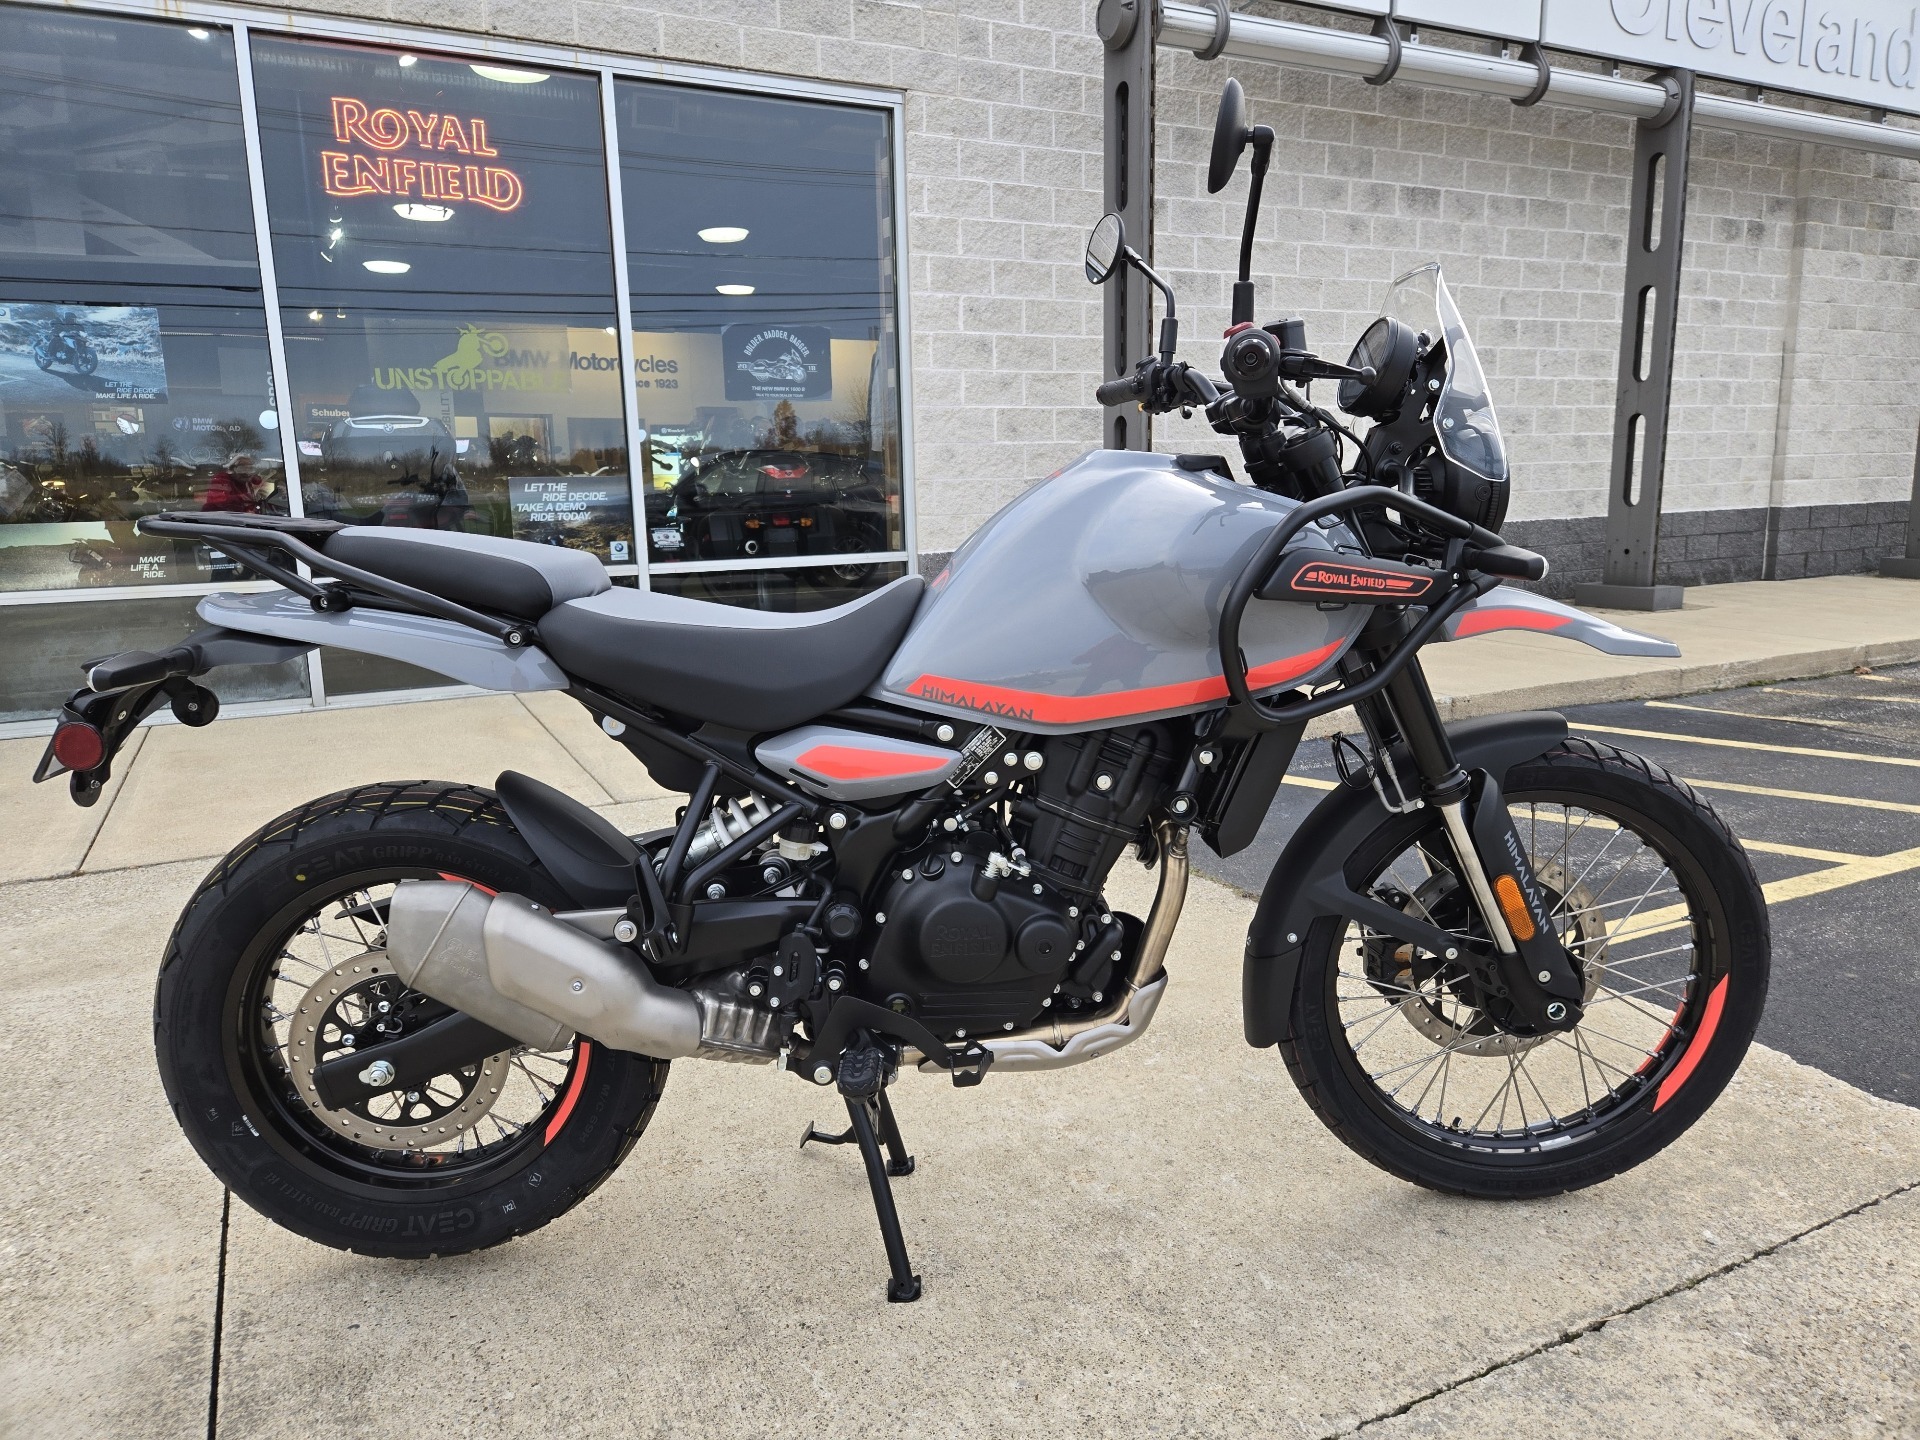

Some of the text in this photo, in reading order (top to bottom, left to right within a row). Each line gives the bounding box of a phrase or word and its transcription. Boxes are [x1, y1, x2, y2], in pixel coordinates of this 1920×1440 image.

[331, 97, 498, 157] ROYAL
[321, 151, 523, 211] ENFIELD
[374, 367, 567, 392] UNSTOPPABLE
[654, 378, 679, 389] 1923
[524, 482, 567, 492] LET THE
[541, 492, 608, 501] RIDE DECIDE.
[517, 502, 587, 512] TAKE A DEMO
[530, 511, 591, 522] RIDE TODAY.
[139, 555, 166, 563] MAKE
[130, 564, 150, 572] LIFE
[1318, 570, 1386, 589] ROYAL ENFIELD
[921, 684, 1034, 720] HIMALAYAN
[1503, 829, 1550, 935] HIMALAYAN
[401, 1207, 475, 1237] CEAT
